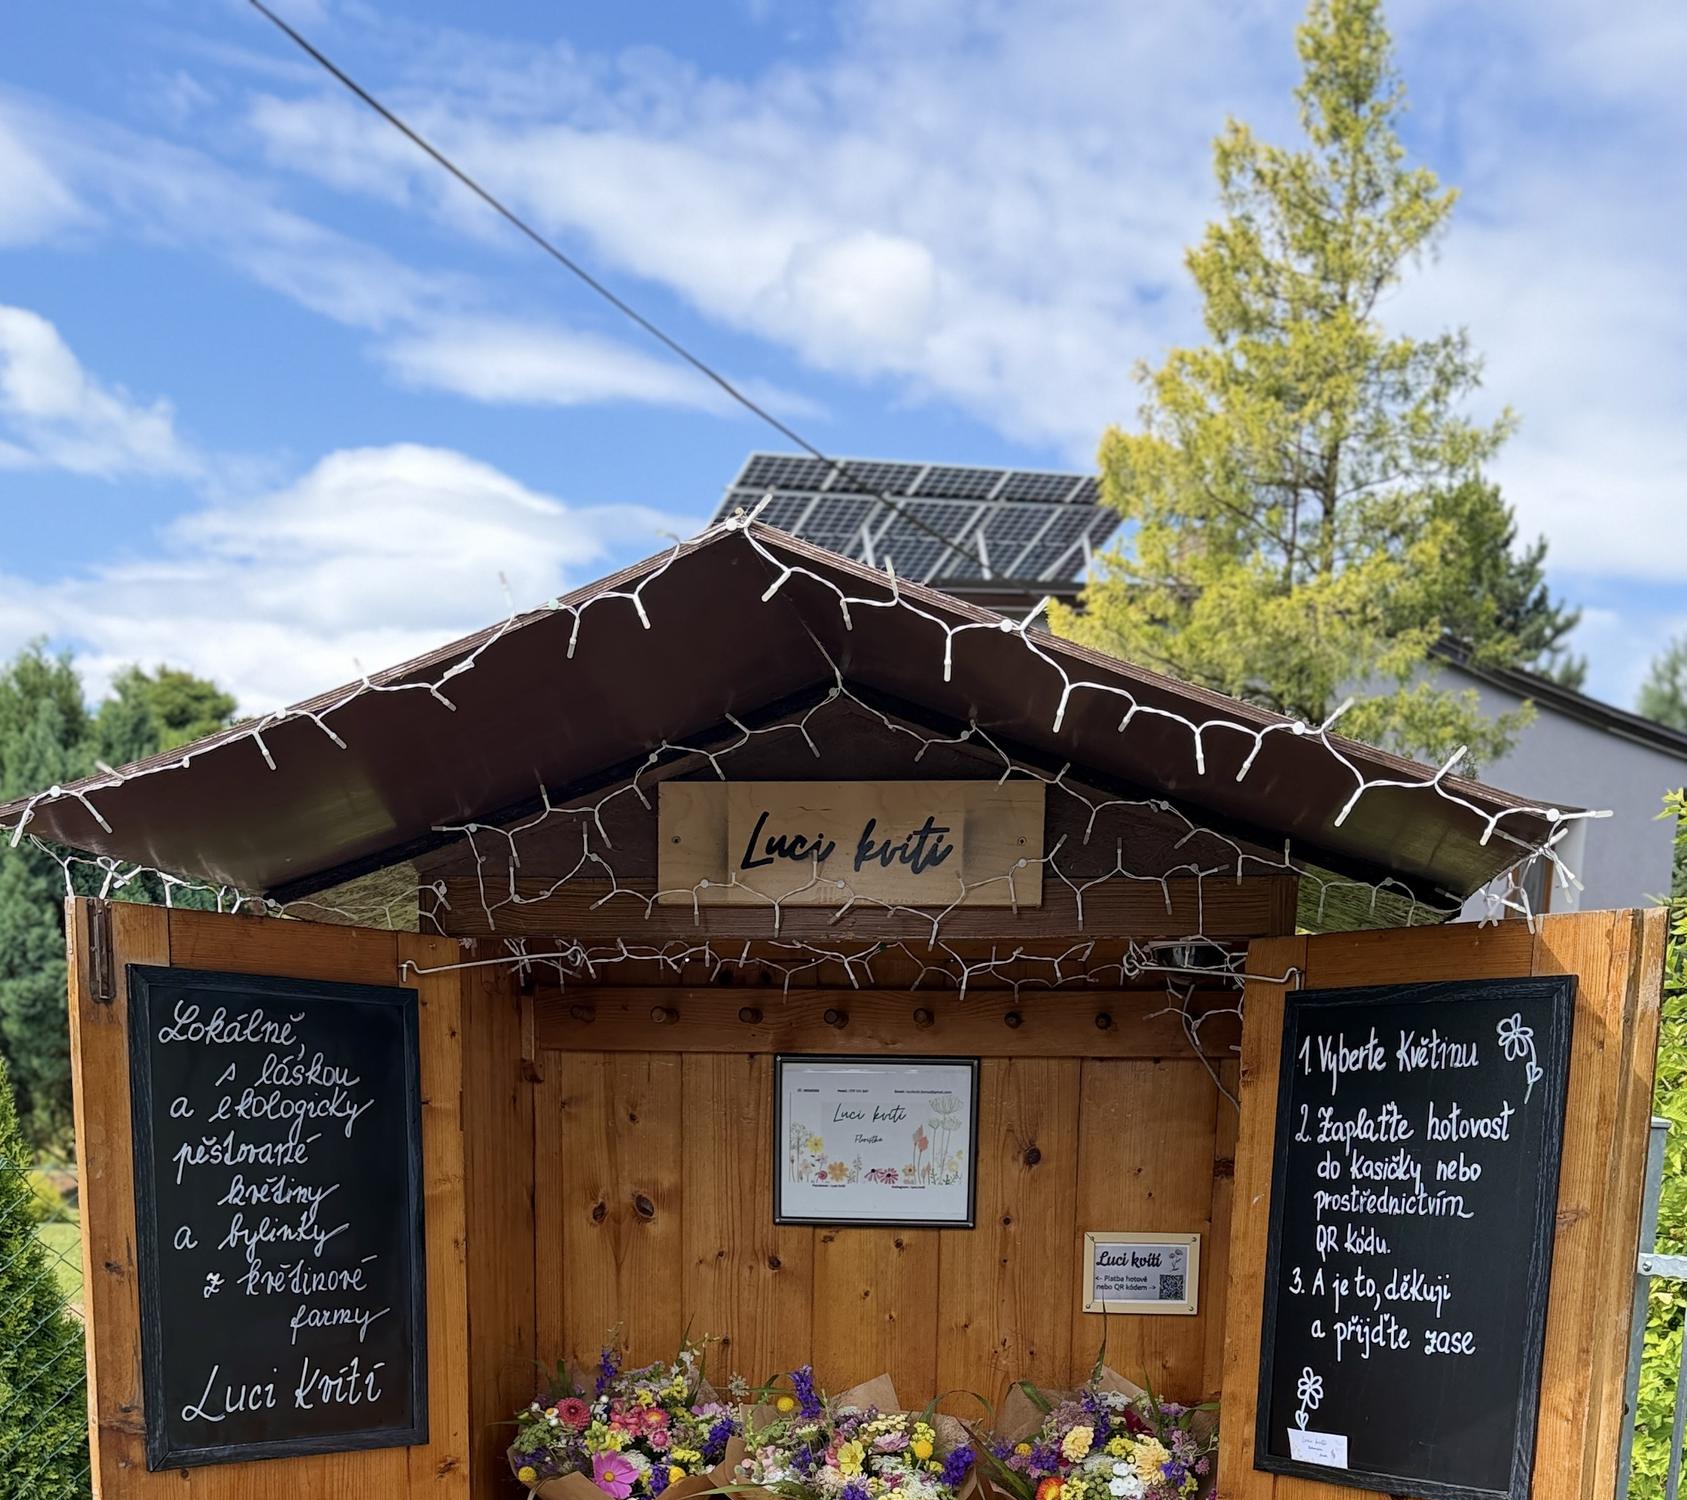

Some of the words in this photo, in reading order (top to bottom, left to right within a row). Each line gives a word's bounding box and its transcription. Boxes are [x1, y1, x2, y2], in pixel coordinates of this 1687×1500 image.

[741, 811, 836, 869] Luci
[215, 1062, 236, 1087] s
[1298, 1035, 1312, 1076] 1.
[1318, 1026, 1387, 1097] Vyberte
[170, 1097, 195, 1118] a
[208, 1087, 375, 1139] ekologicky
[833, 1103, 866, 1122] Luci
[1294, 1103, 1312, 1142] 2.
[1427, 1100, 1516, 1142] hotovost
[1316, 1149, 1341, 1180] do
[1435, 1152, 1482, 1182] nebo
[1313, 1182, 1475, 1222] prostřednictvím
[173, 1225, 199, 1250] a
[217, 1211, 351, 1263] bylinky
[1315, 1224, 1339, 1261] QR
[1096, 1251, 1129, 1267] Luci
[203, 1272, 225, 1299] z
[1114, 1283, 1124, 1291] QR
[1289, 1266, 1305, 1295] 3.
[1311, 1267, 1326, 1296] A
[1332, 1273, 1350, 1314] je
[1354, 1266, 1381, 1312] to,
[289, 1304, 391, 1345] farmy
[1311, 1319, 1326, 1338] a
[1424, 1329, 1476, 1355] zase
[181, 1364, 277, 1422] Luci
